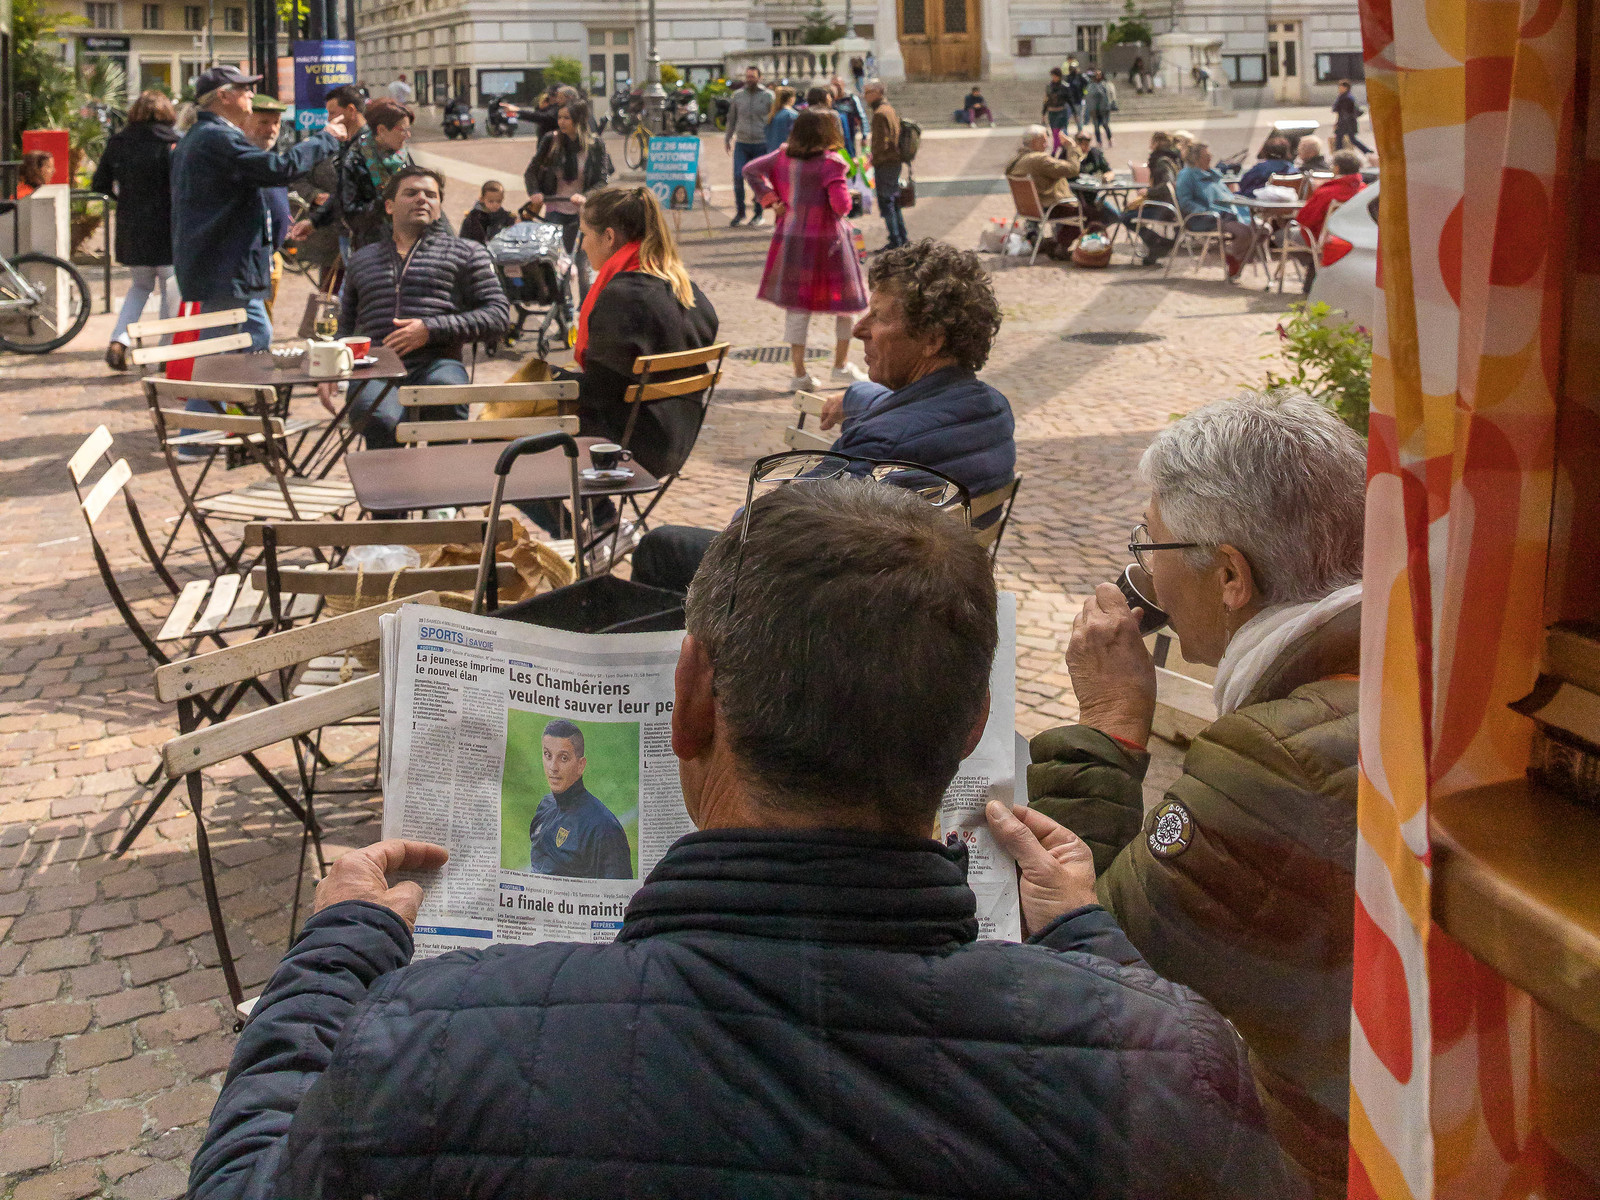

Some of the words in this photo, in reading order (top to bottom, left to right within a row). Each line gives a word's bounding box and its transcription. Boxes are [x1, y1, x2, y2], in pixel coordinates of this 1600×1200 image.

[650, 142, 662, 151] LE
[678, 142, 698, 151] MAI
[650, 152, 696, 162] VOTONS
[420, 626, 464, 644] SPORTS
[468, 638, 494, 649] SAVOIE
[416, 652, 428, 662] La
[430, 654, 468, 668] jeunesse
[470, 660, 505, 675] imprime
[416, 664, 425, 674] le
[428, 666, 458, 678] nouvel
[459, 669, 478, 682] élan
[509, 668, 532, 684] Les
[536, 672, 630, 696] Chambériens
[508, 689, 560, 709] veulent
[564, 698, 612, 714] sauver
[618, 700, 650, 714] leur
[499, 892, 514, 908] La
[518, 894, 554, 912] finale
[558, 900, 574, 914] du
